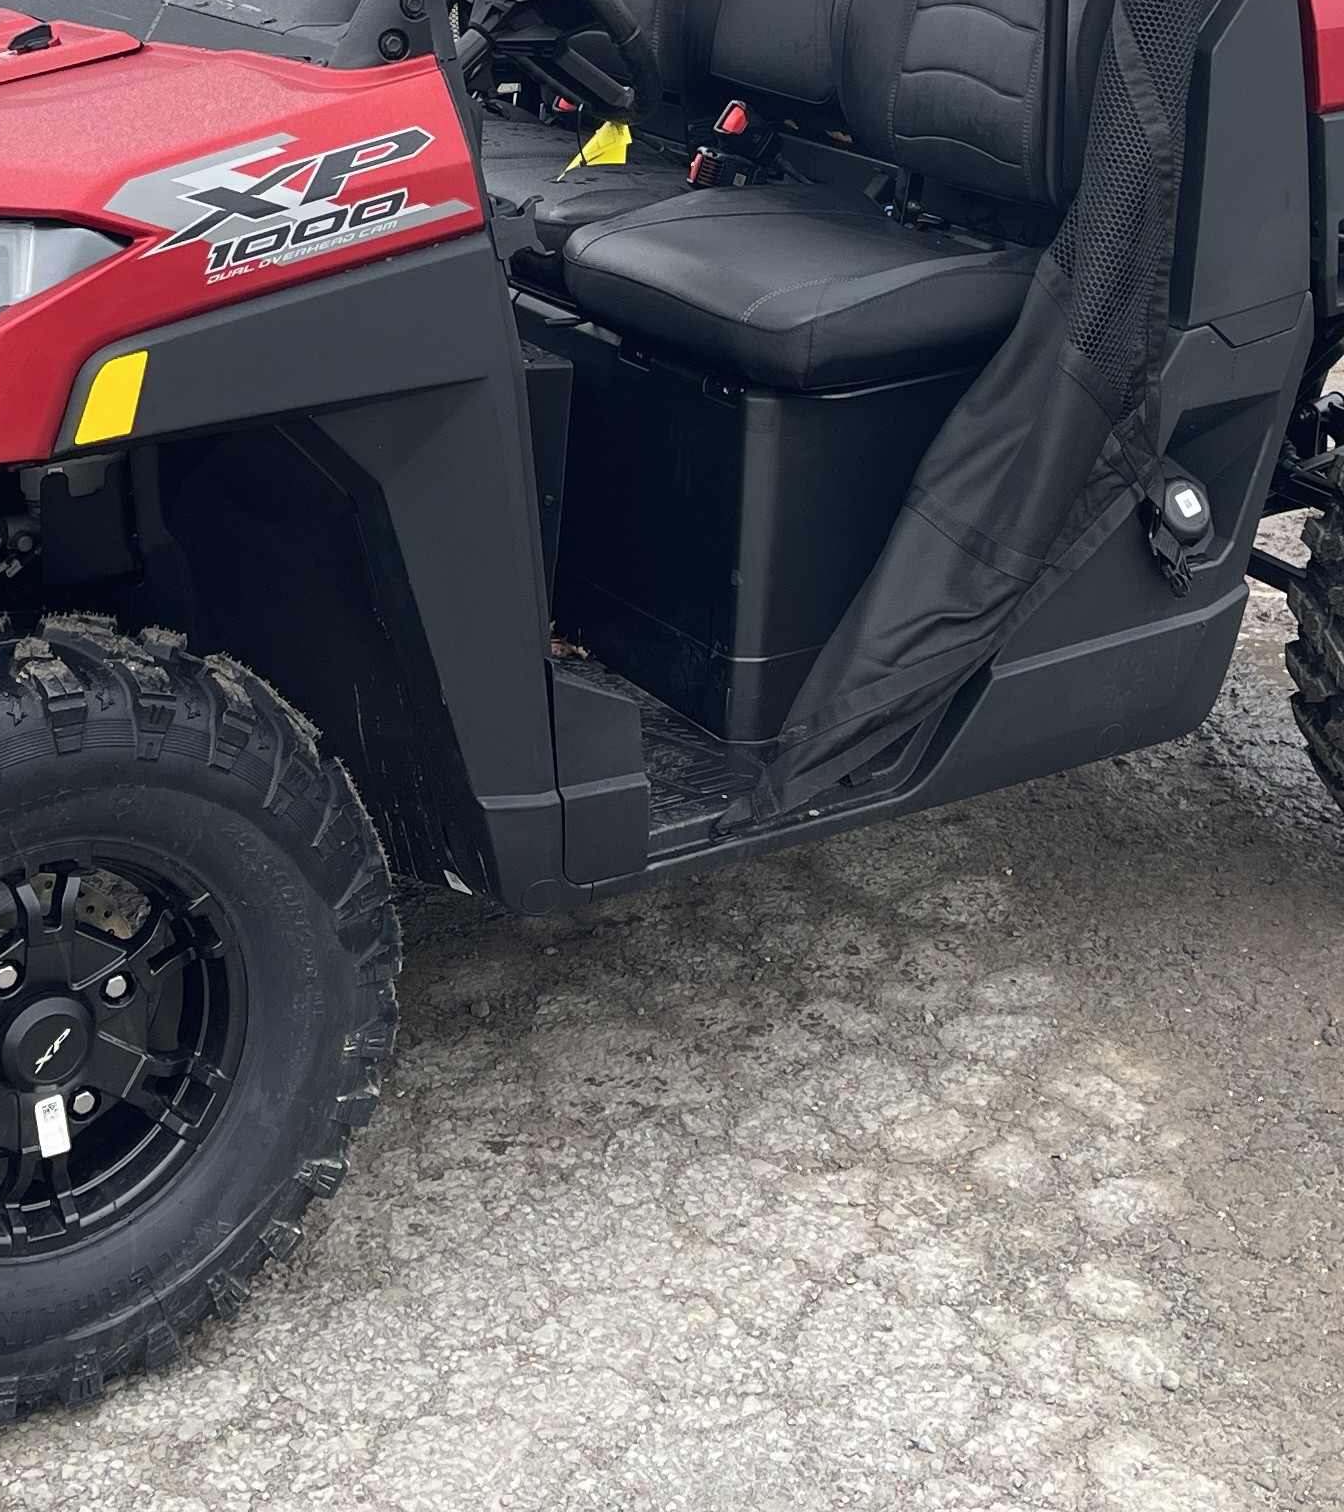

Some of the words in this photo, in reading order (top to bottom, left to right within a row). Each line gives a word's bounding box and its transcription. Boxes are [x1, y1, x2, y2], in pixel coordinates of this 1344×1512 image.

[138, 126, 436, 260] XP
[204, 187, 409, 275] 1000
[207, 265, 255, 285] DUAL
[258, 233, 355, 269] OVERHEAD
[358, 220, 398, 238] CAM
[34, 1027, 71, 1075] XP
